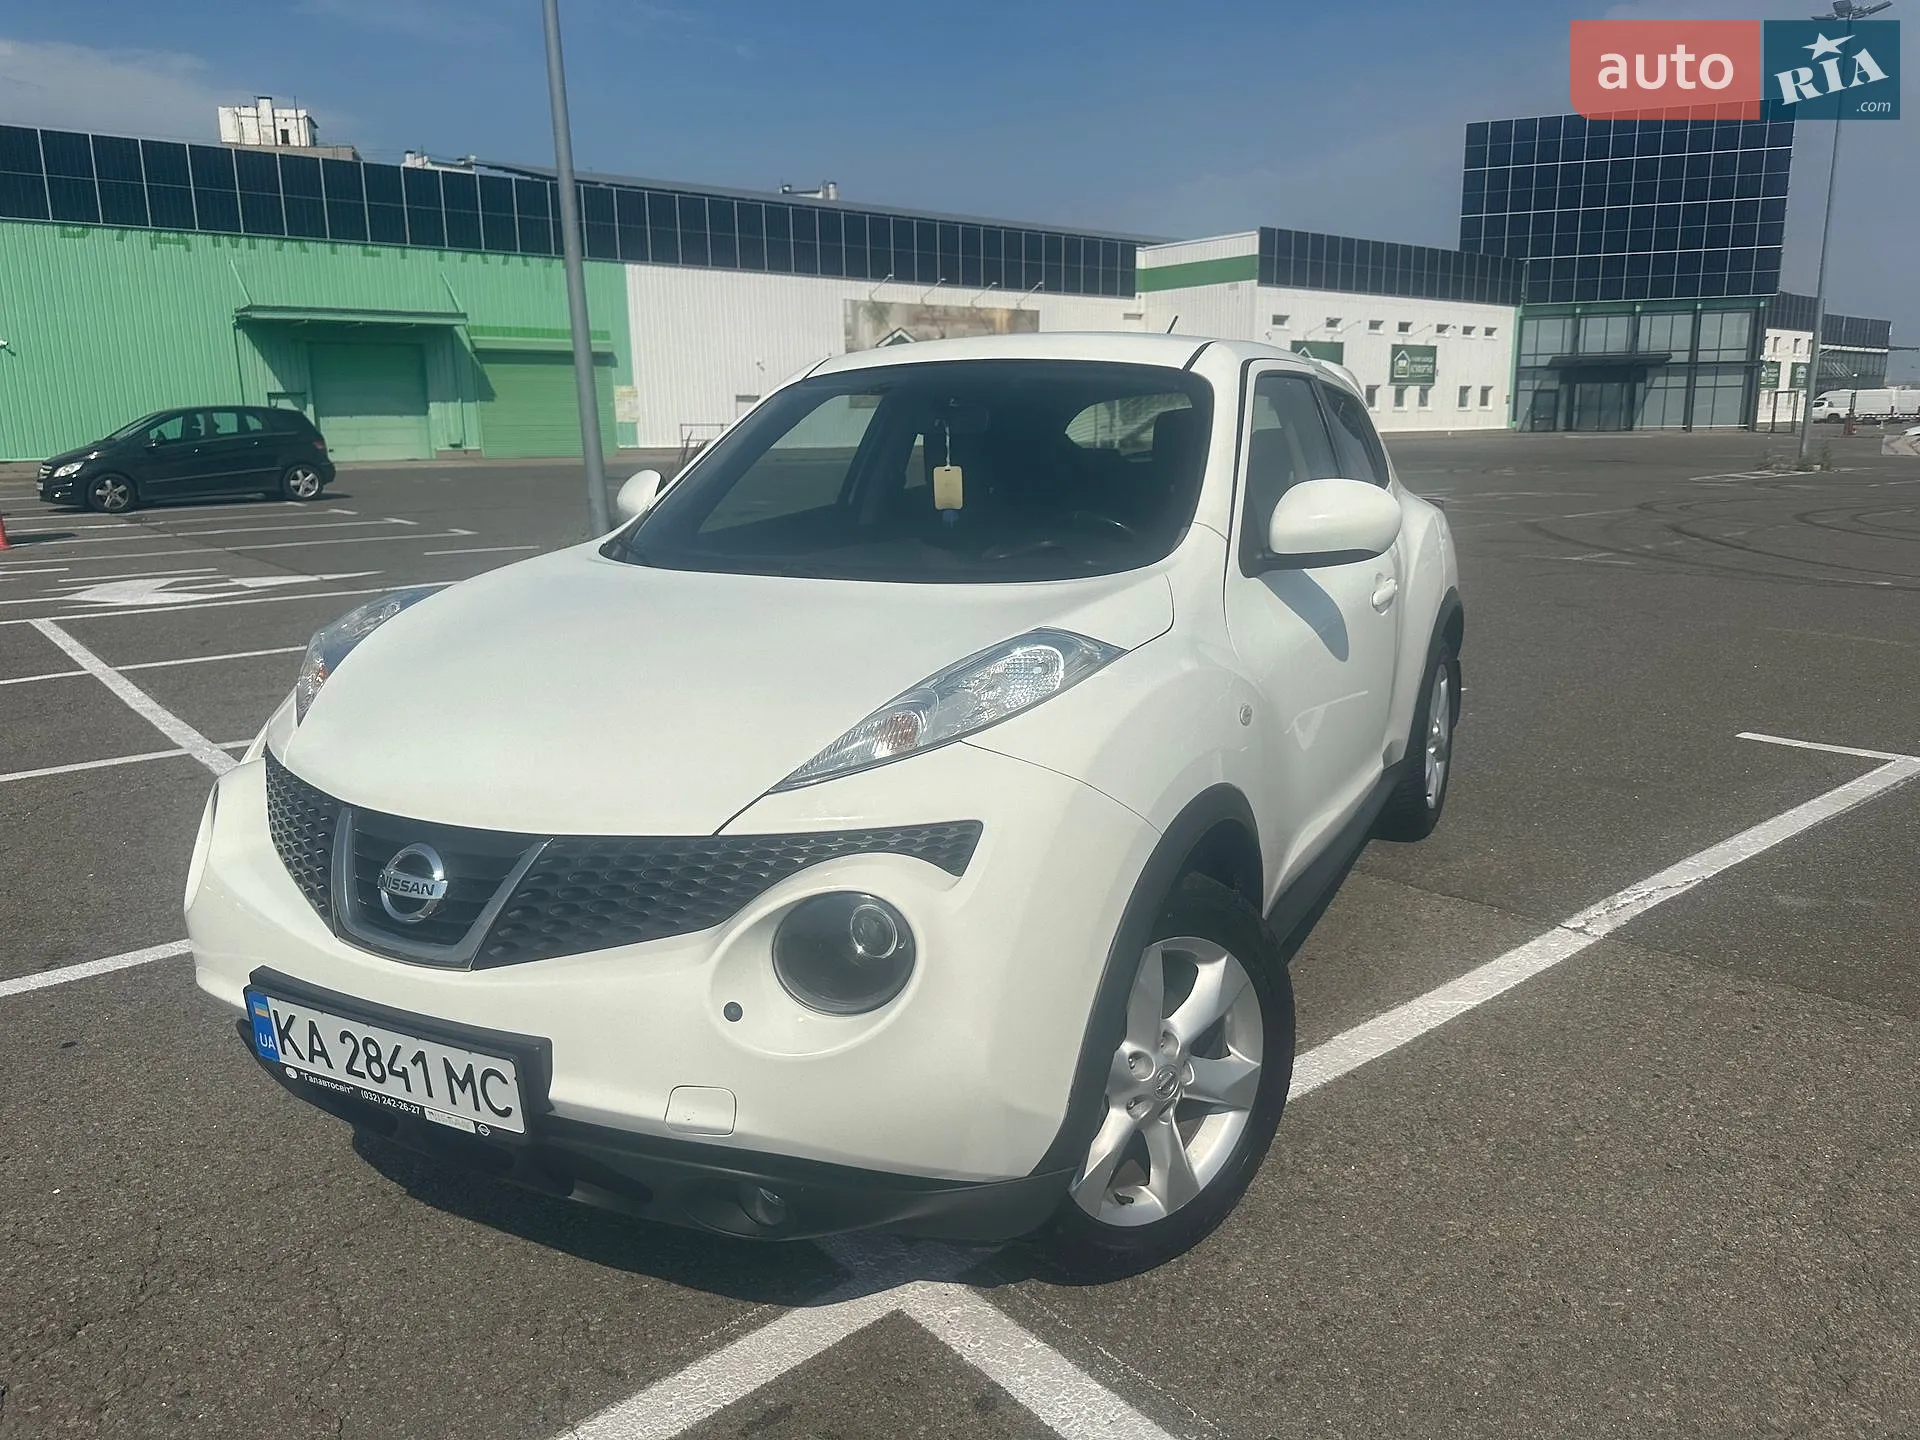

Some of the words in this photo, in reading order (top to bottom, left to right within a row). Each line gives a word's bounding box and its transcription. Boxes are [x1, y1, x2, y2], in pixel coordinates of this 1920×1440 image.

[382, 875, 435, 896] NISSAN
[258, 1032, 276, 1051] UA
[272, 1009, 334, 1070] KA
[339, 1030, 434, 1099] 2841
[443, 1056, 513, 1118] MC
[361, 1089, 381, 1103] (032)
[382, 1096, 420, 1115] 242-26-27
